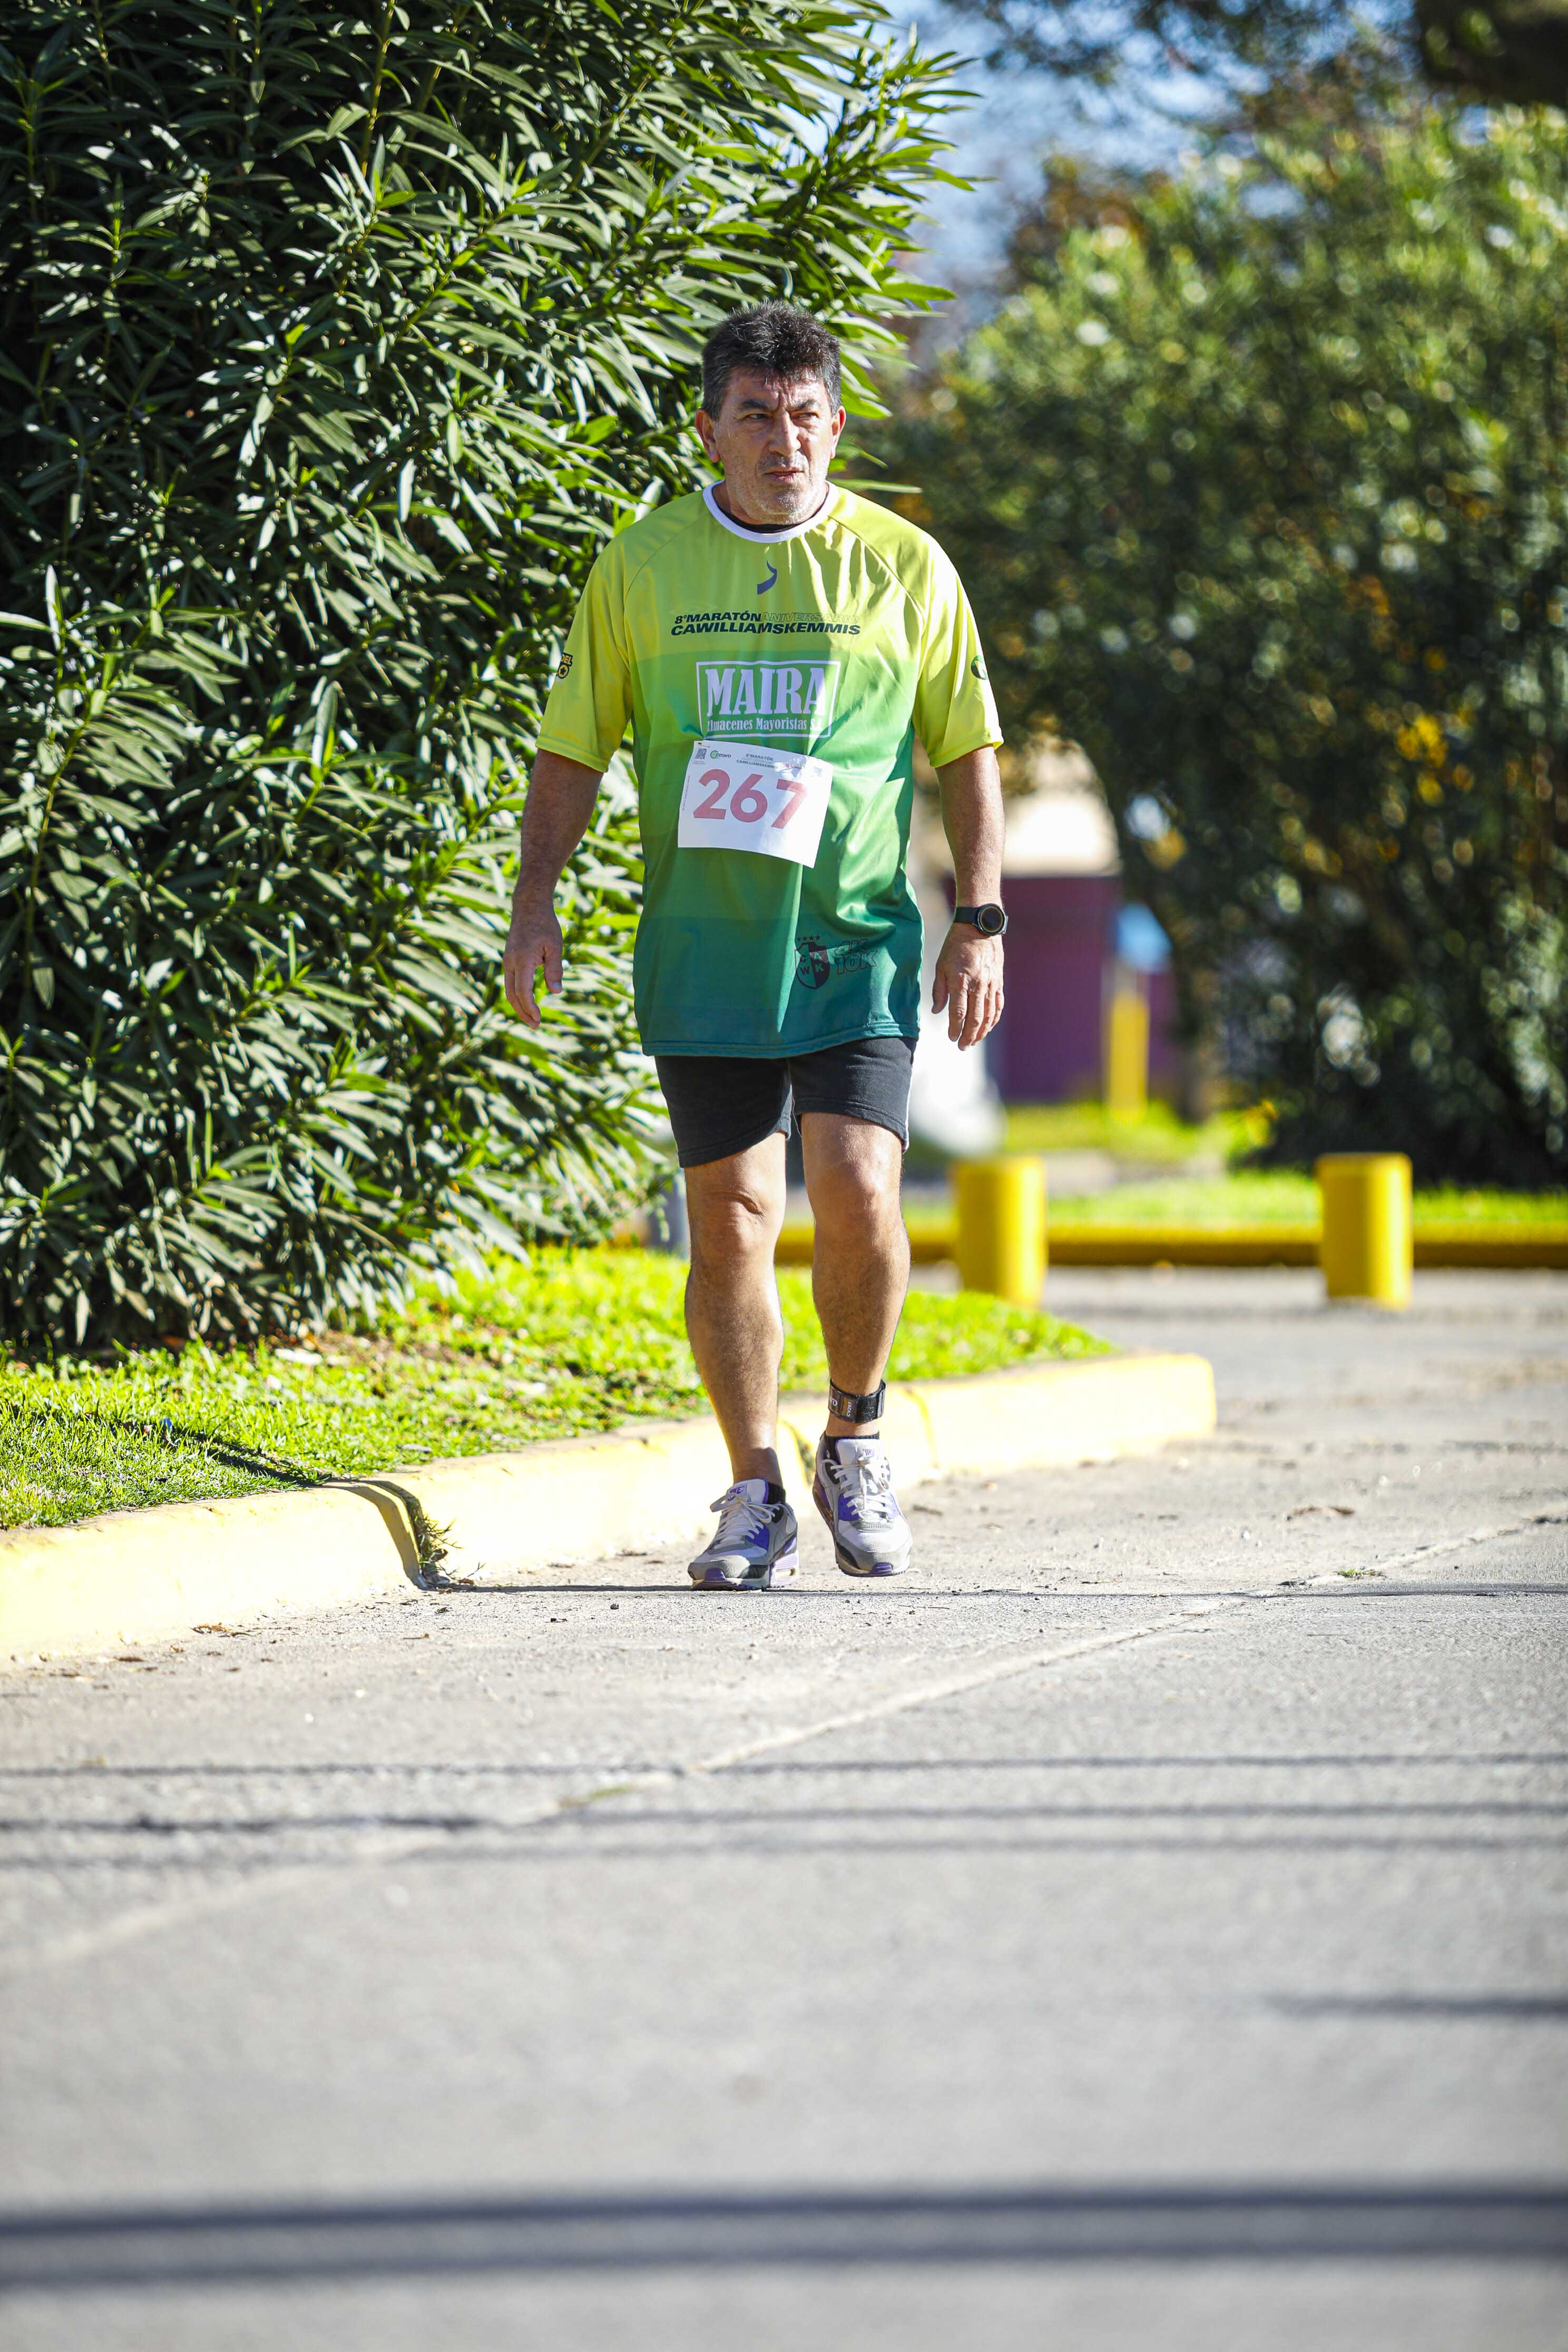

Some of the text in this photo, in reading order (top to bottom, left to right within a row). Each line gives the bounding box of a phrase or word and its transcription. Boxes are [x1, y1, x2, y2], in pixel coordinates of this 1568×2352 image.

[671, 622, 861, 635] CAWILLIAMSKEMMIS
[705, 667, 827, 717] MAIRA
[756, 717, 807, 731] Mayoristas
[693, 768, 806, 829] 267
[834, 949, 878, 975] 10K
